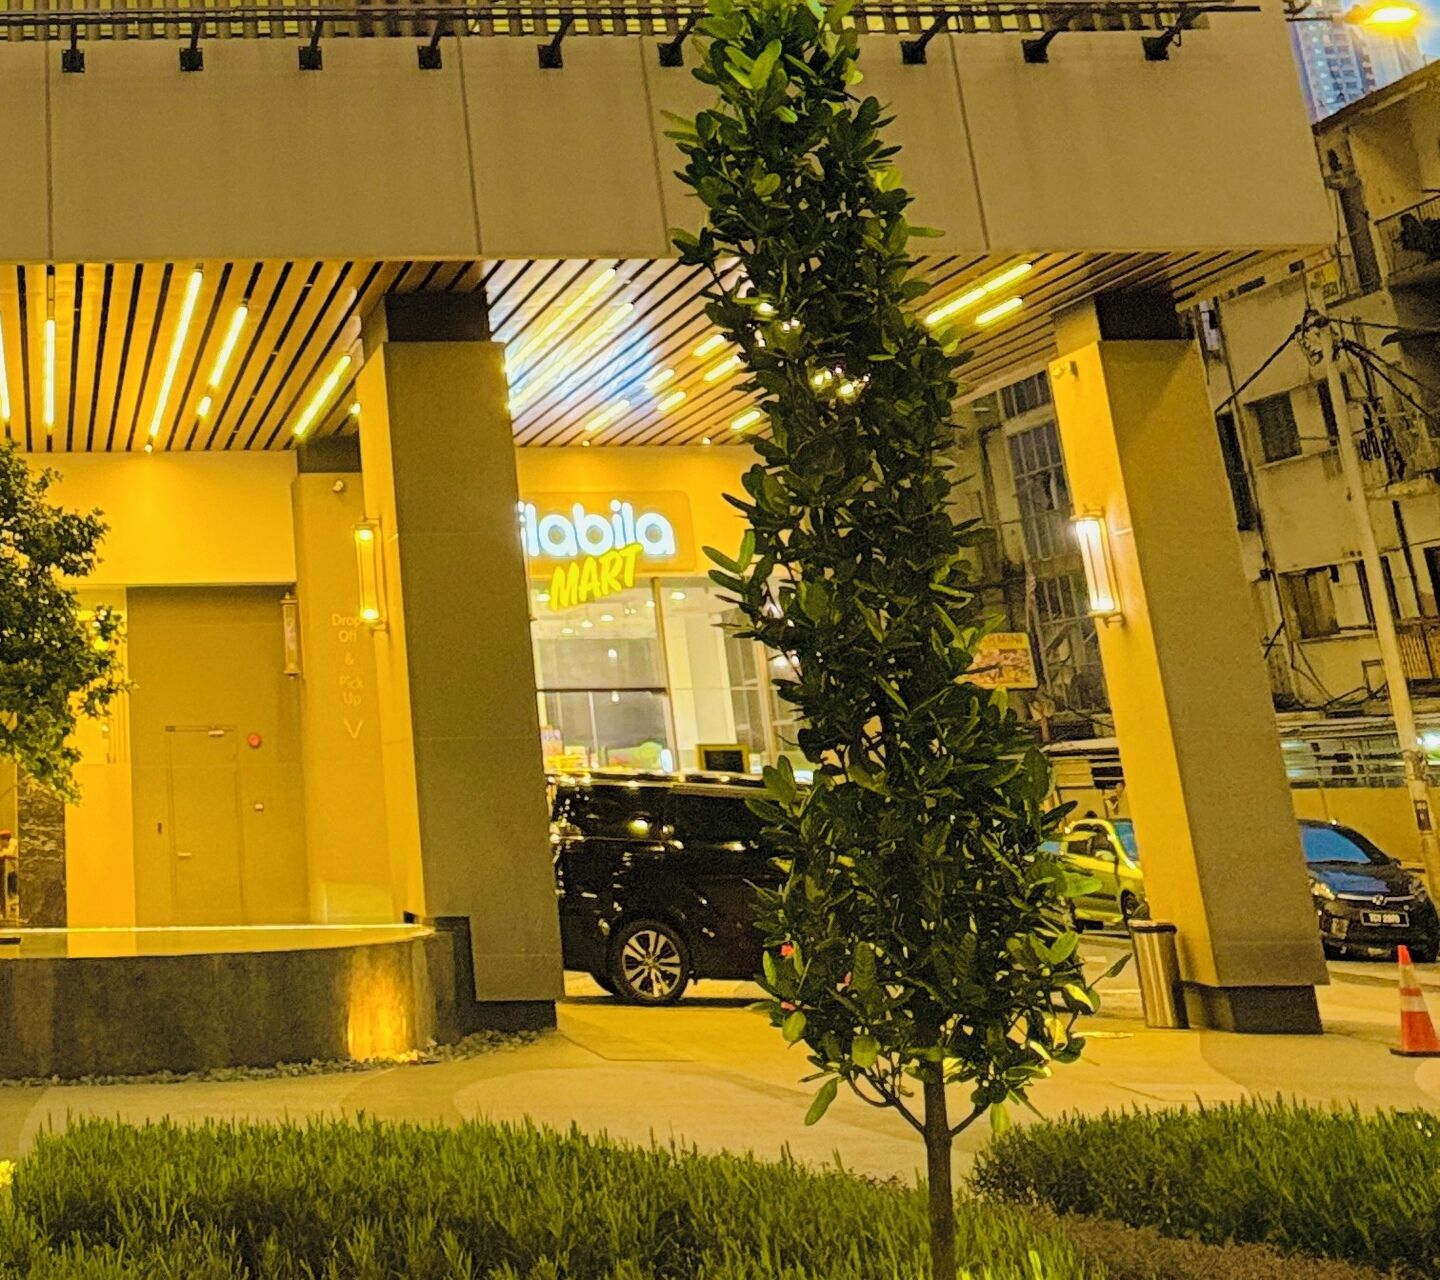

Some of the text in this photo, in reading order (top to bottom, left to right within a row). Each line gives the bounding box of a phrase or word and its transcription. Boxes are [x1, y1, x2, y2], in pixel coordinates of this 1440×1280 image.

[548, 542, 644, 611] MART
[338, 629, 357, 643] Off
[343, 691, 362, 707] Up
